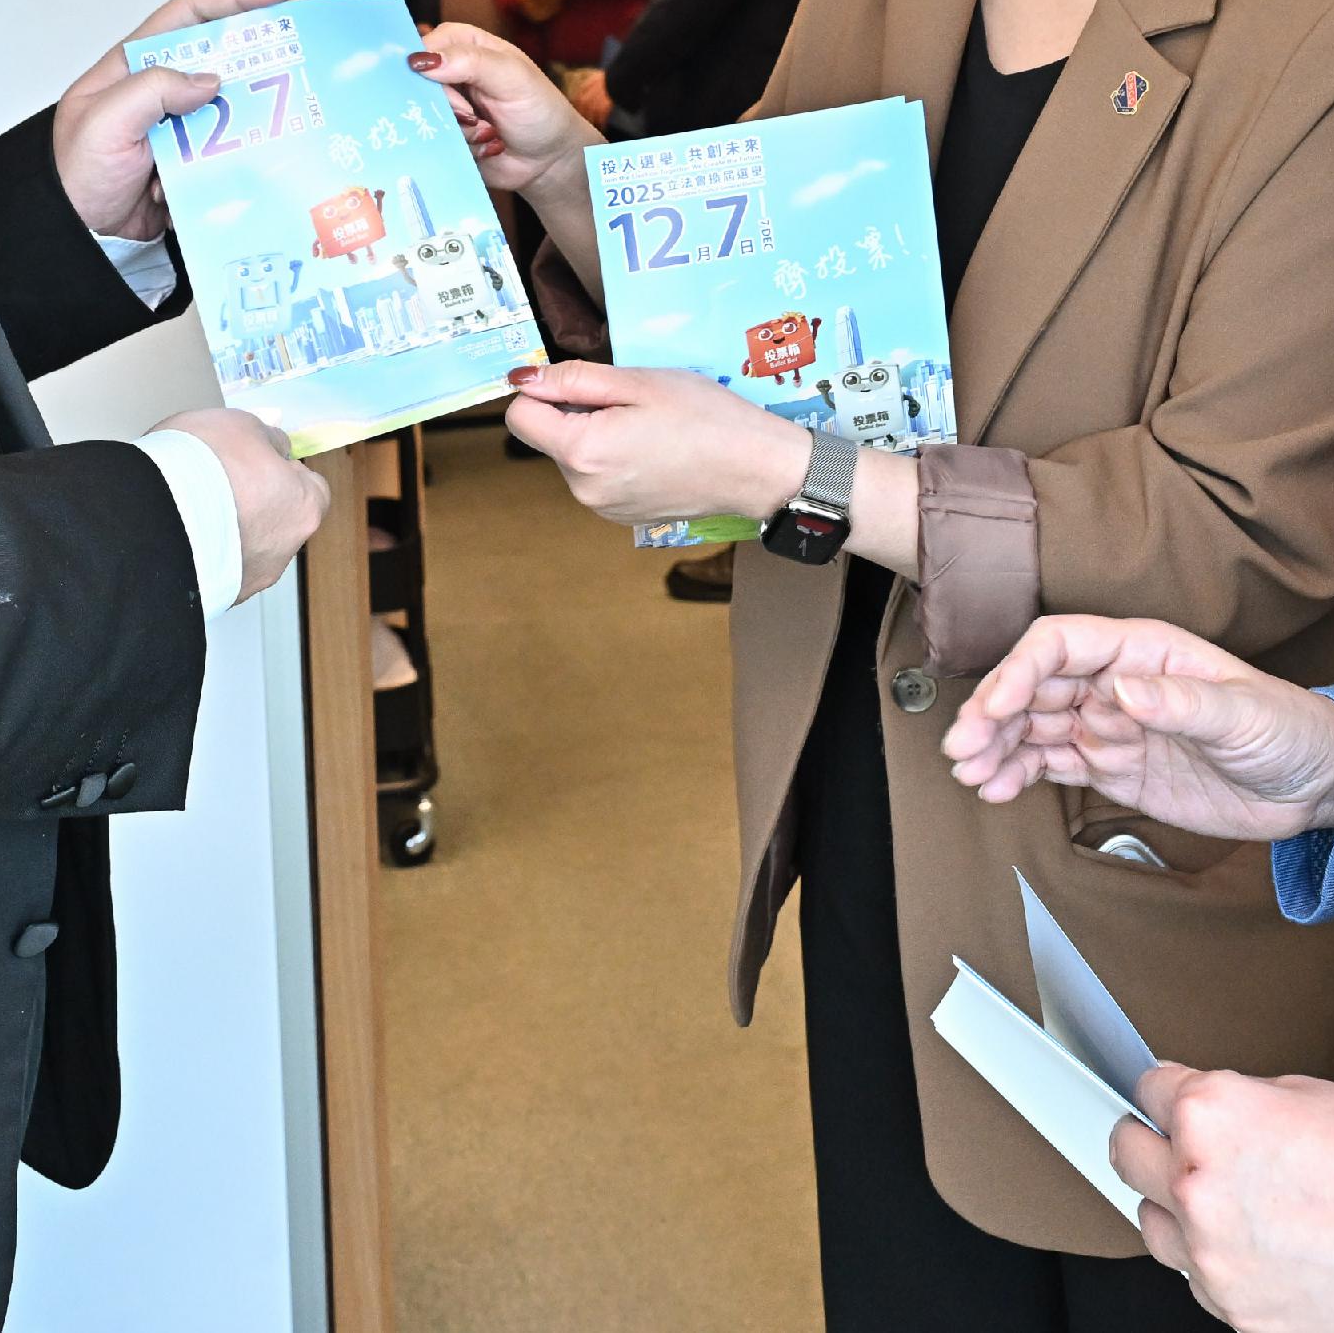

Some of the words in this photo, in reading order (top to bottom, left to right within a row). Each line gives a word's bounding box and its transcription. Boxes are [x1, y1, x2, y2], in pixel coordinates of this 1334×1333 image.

[226, 18, 292, 45] 共創未來
[308, 104, 323, 126] DEC
[601, 151, 674, 176] 投入選舉
[689, 138, 759, 161] 共創未來
[606, 182, 665, 207] 2025
[668, 165, 762, 191] 立法會換屆選舉
[761, 228, 774, 250] DEC
[438, 283, 474, 304] 投票箱
[764, 343, 801, 363] 投票箱
[853, 410, 889, 427] 投票箱
